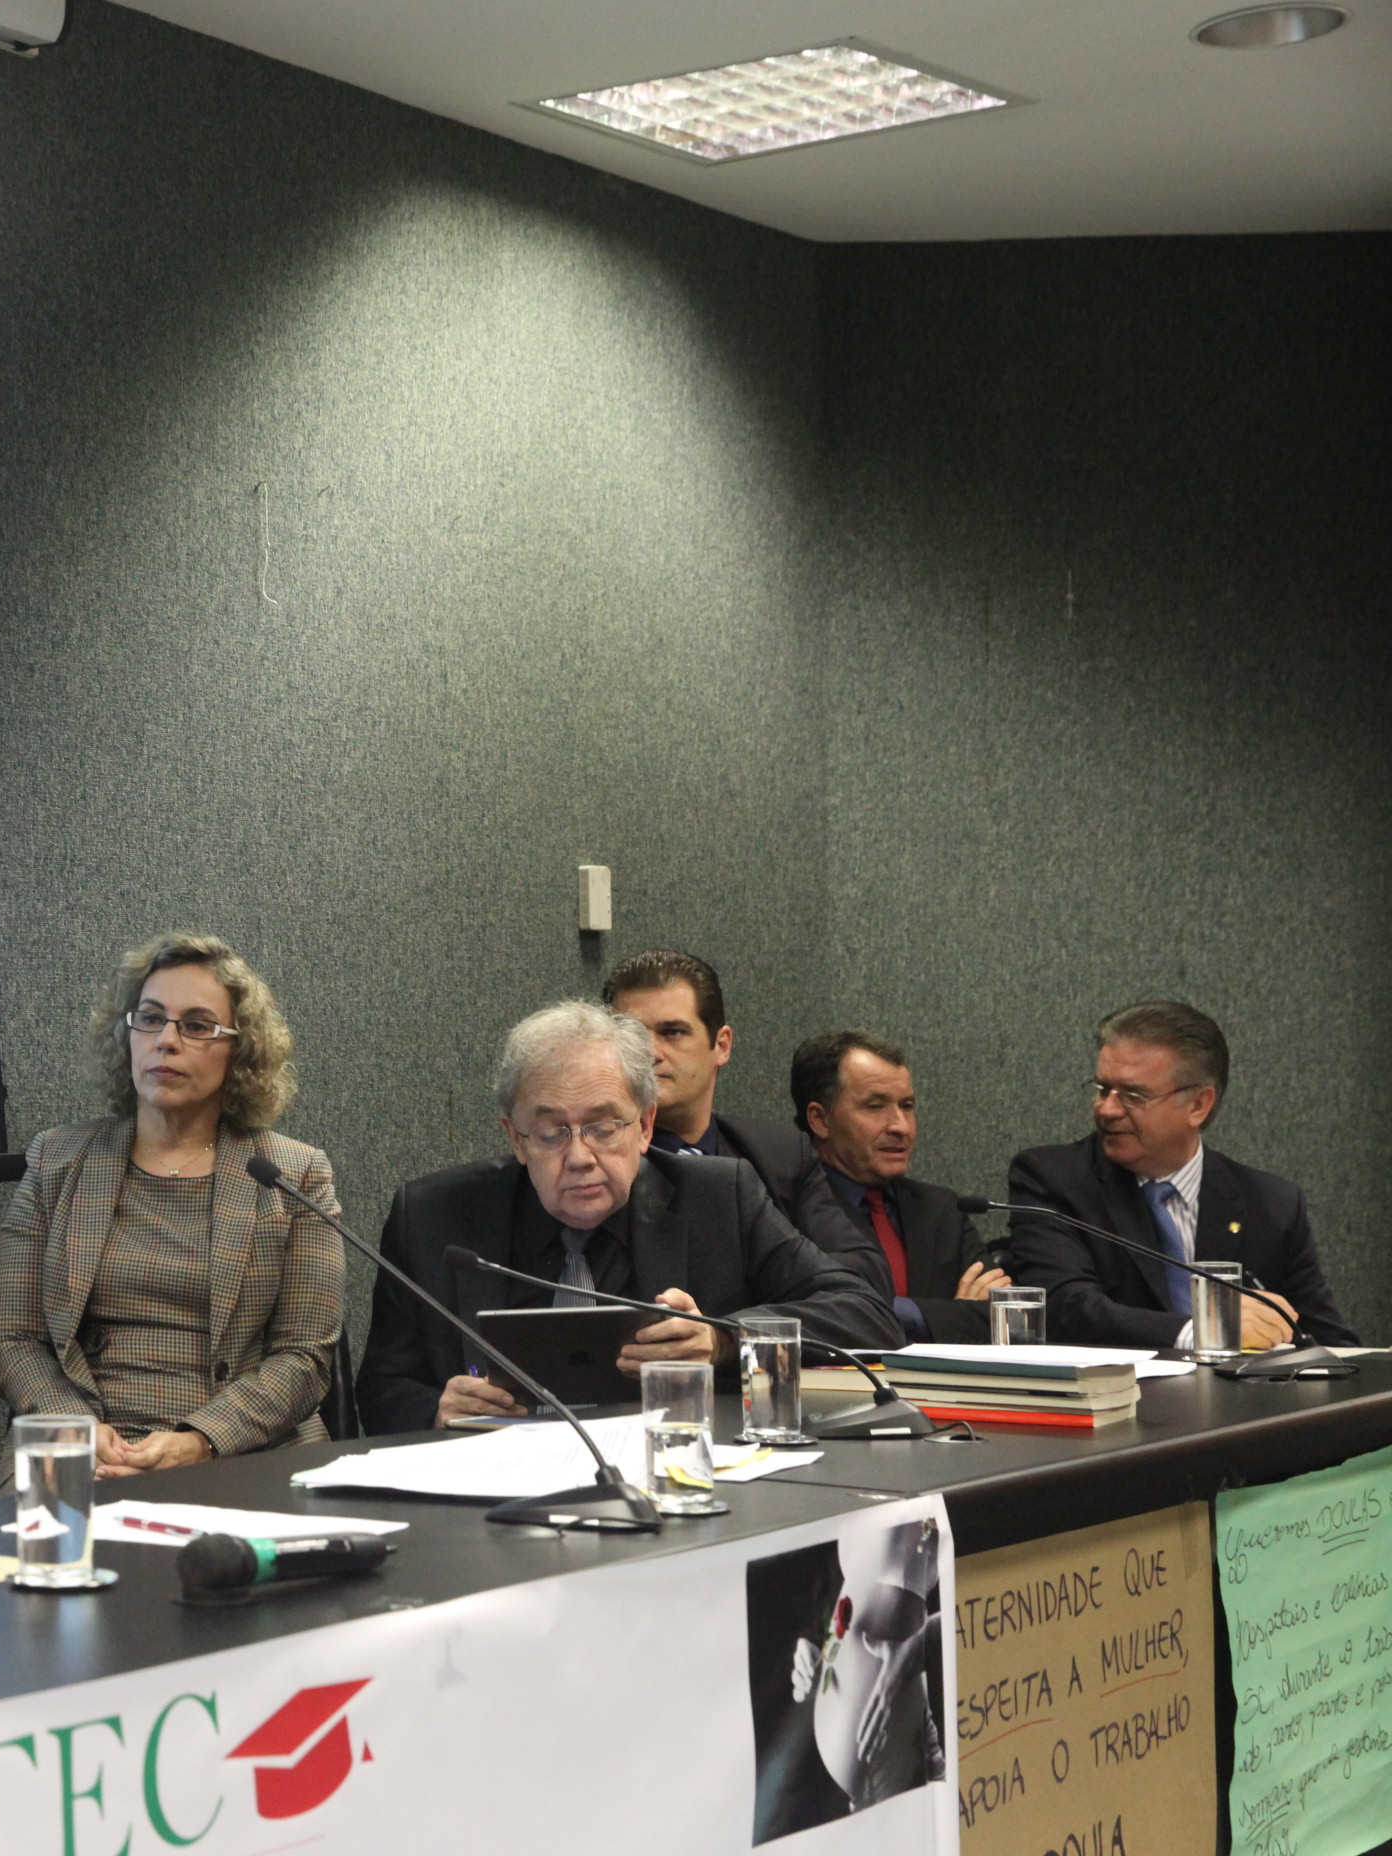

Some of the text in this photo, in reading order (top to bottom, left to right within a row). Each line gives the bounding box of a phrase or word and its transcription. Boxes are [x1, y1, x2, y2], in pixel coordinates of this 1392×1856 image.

[1316, 1488, 1382, 1540] DOULAS
[1124, 1548, 1168, 1597] QUE
[1314, 1599, 1322, 1620] e
[1068, 1655, 1083, 1698] A
[1100, 1609, 1189, 1683] MULHER,
[1355, 1683, 1364, 1706] e
[958, 1694, 1191, 1829] APOIA O TRABALHO
[1043, 1814, 1127, 1856] OULA
